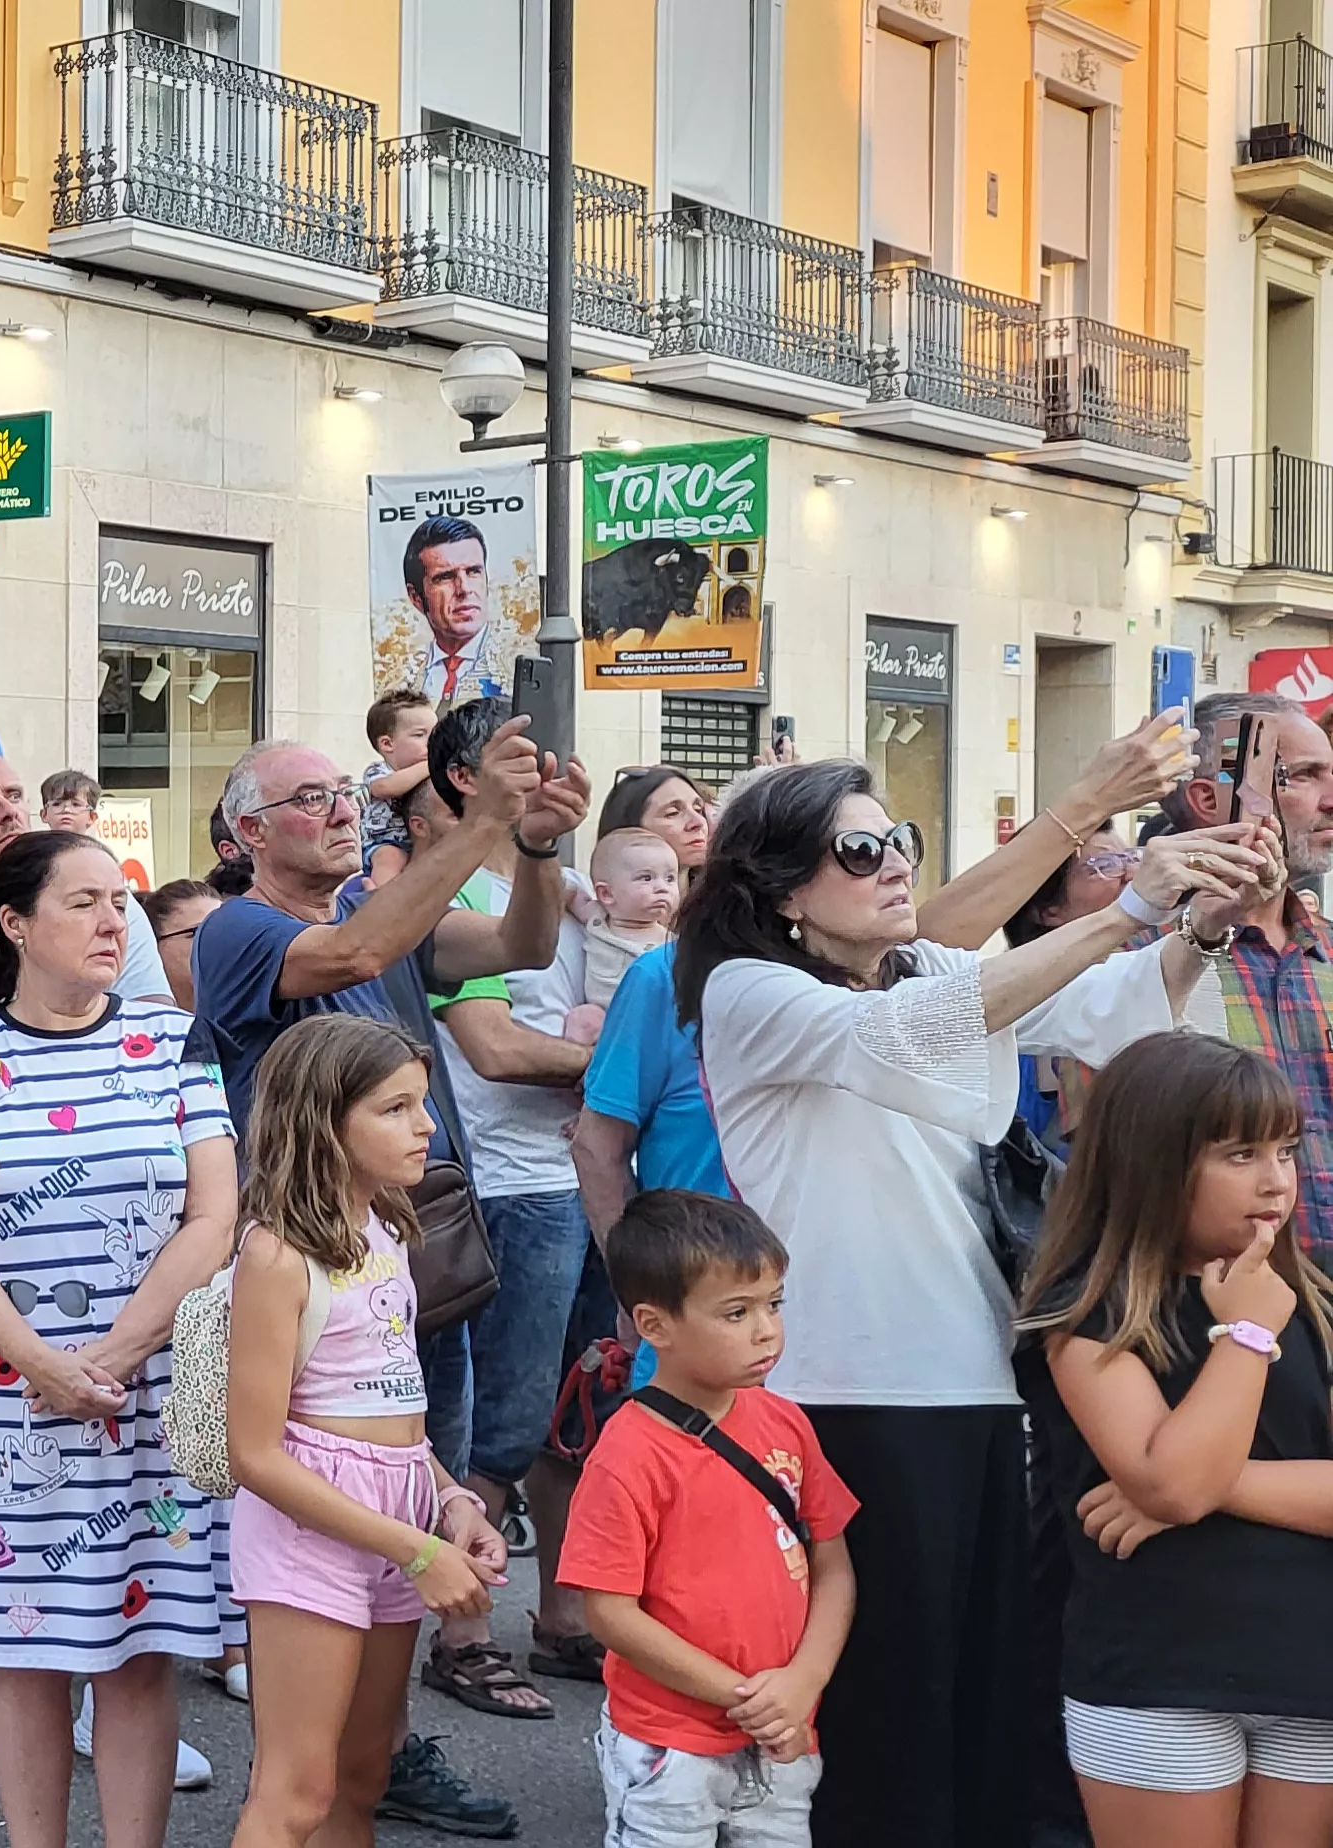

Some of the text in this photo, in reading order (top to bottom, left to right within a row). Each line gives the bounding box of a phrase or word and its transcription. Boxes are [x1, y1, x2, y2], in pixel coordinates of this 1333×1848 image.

[415, 486, 485, 503] EMILIO
[594, 452, 757, 519] TOROS EN
[379, 496, 524, 523] DE JUSTO
[596, 512, 754, 542] HUESCA
[101, 560, 254, 616] Pilar Prieto
[1073, 610, 1082, 636] 2
[601, 661, 743, 676] www.tauroemocion.com
[619, 650, 662, 663] Compra
[663, 651, 680, 661] tus
[865, 640, 947, 680] Pilar Prieto
[10, 1186, 43, 1222] MY
[39, 1159, 91, 1200] DIOR
[3, 1495, 25, 1505] Keep
[42, 1543, 71, 1572] OH
[87, 1500, 133, 1541] DIOR
